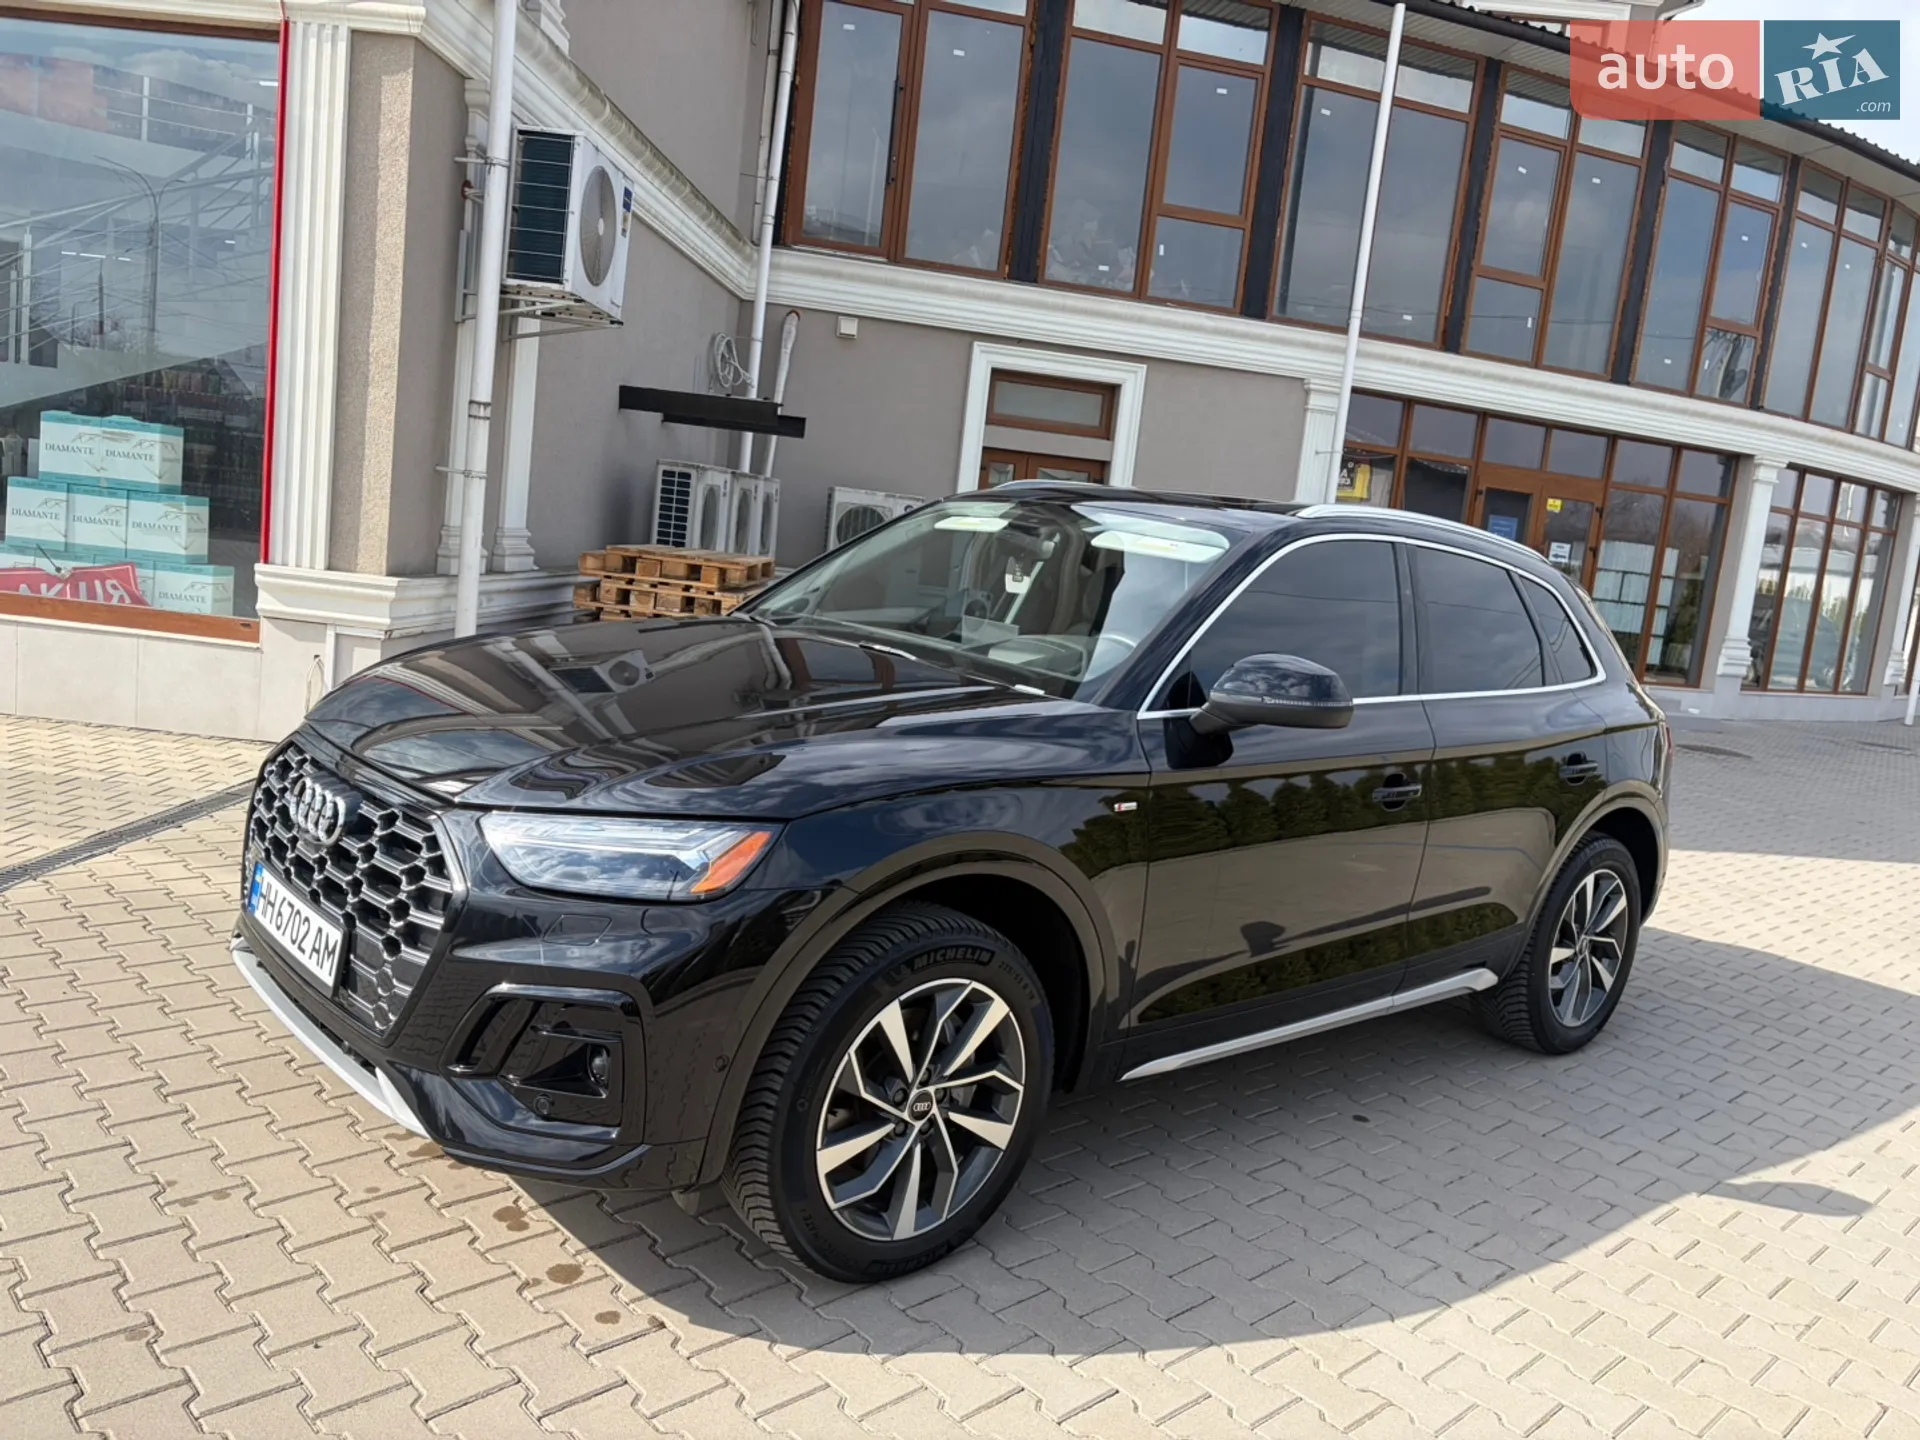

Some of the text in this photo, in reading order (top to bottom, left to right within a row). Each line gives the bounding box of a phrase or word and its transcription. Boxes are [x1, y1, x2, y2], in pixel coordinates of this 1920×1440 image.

[45, 442, 95, 456] DIAMANTE
[105, 449, 155, 462] DIAMANTE
[11, 507, 60, 521] DIAMANTE
[72, 514, 122, 528] DIAMANTE
[131, 520, 181, 534] DIAMANTE
[158, 591, 207, 604] DIAMANTE
[912, 946, 993, 970] MICHELIN
